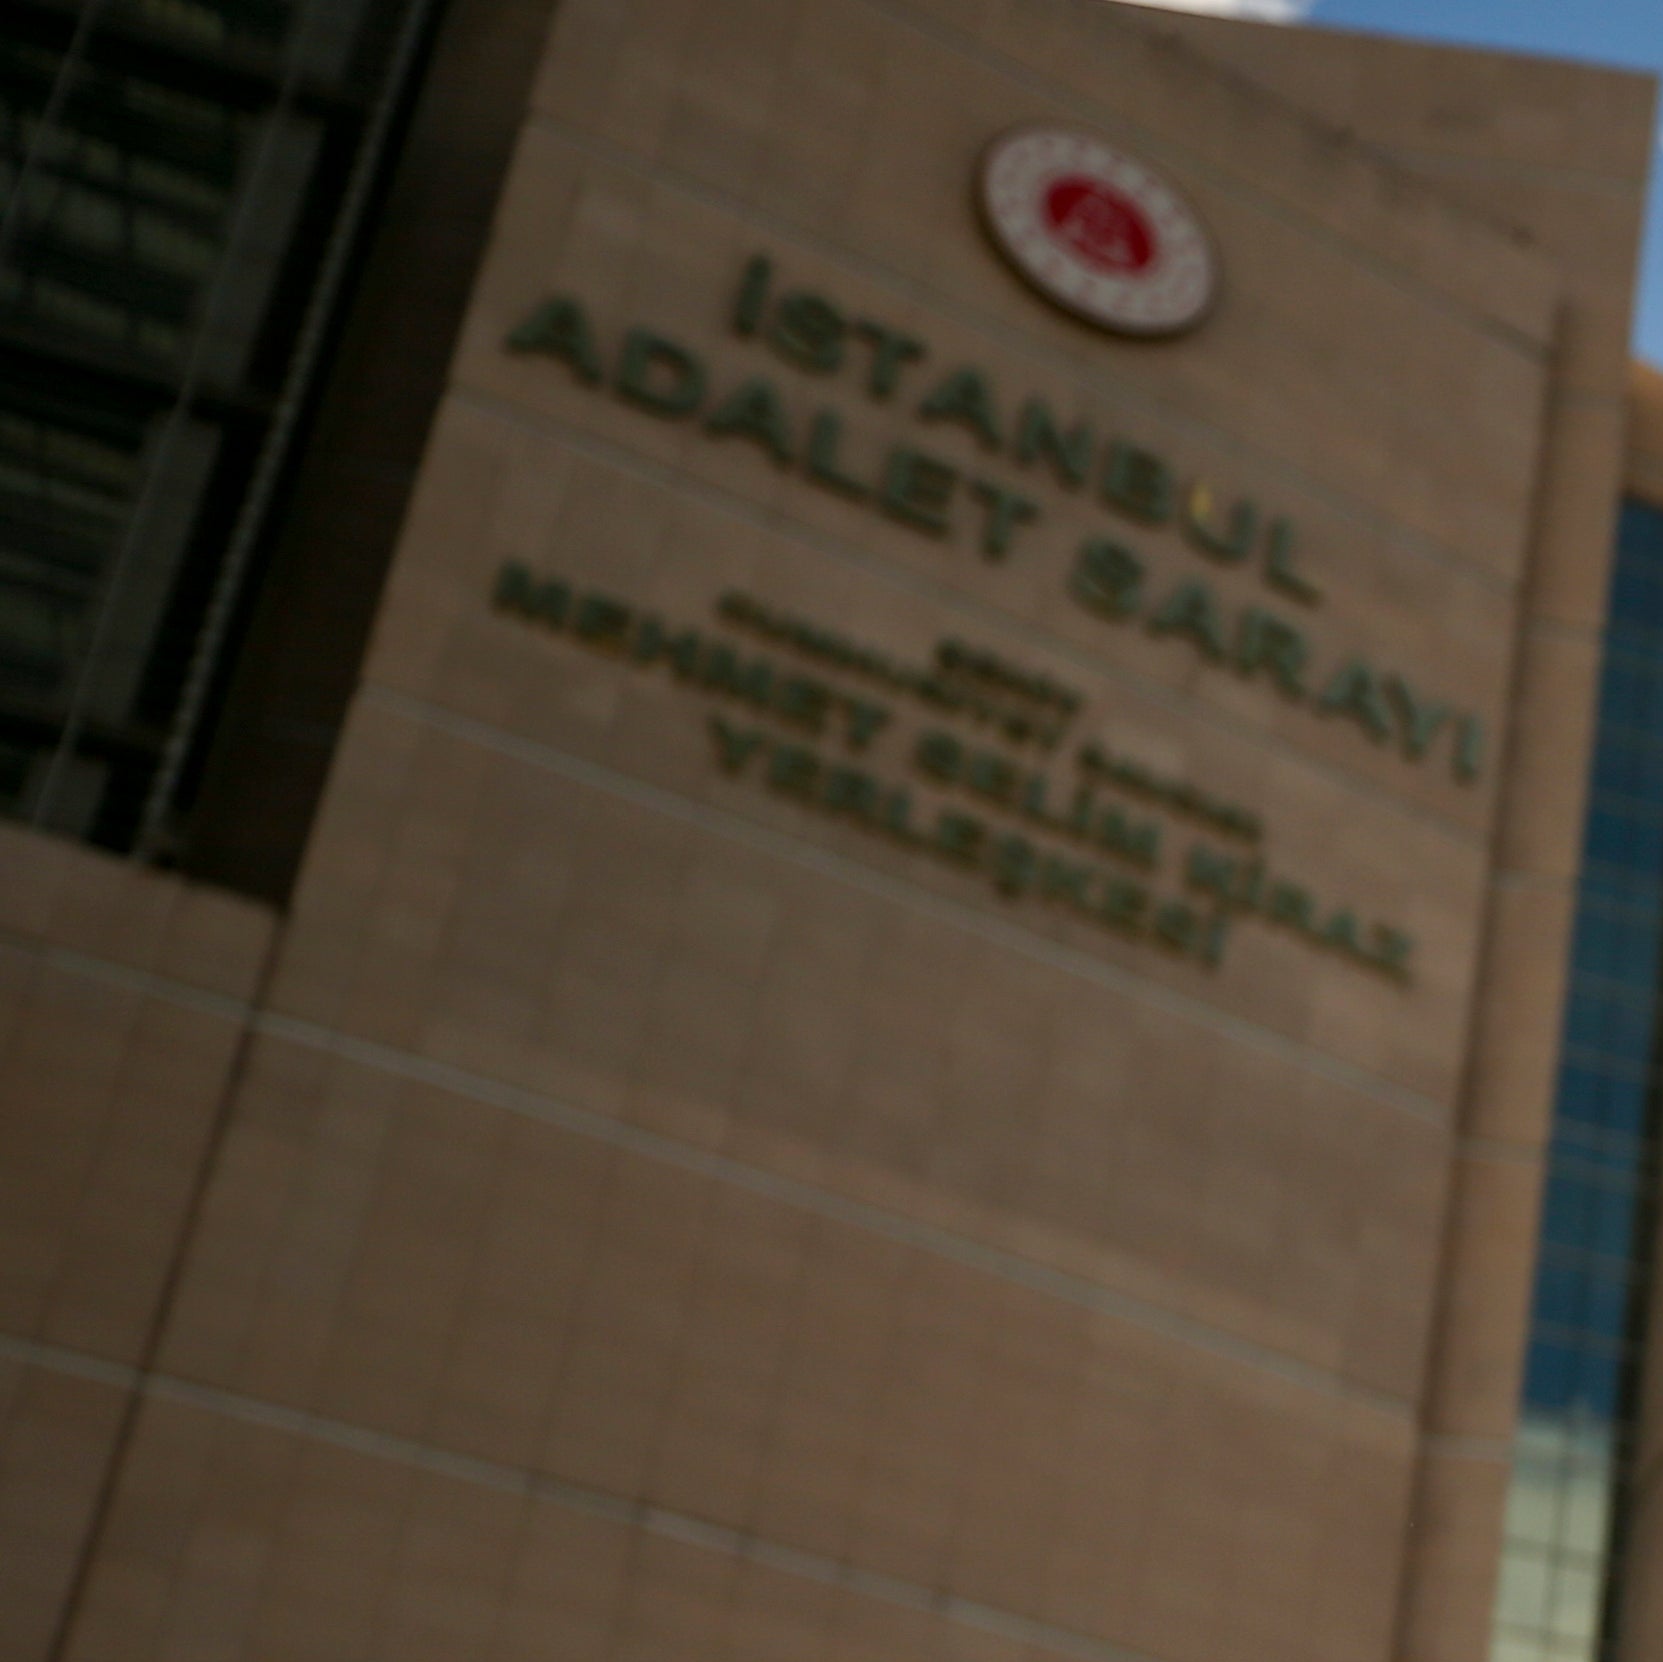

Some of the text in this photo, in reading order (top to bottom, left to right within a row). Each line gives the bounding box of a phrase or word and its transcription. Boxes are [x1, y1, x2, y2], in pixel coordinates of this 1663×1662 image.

[504, 295, 1040, 564] ADALET
[1068, 539, 1484, 790] SARAYI
[730, 252, 1322, 608] İSTANBUL
